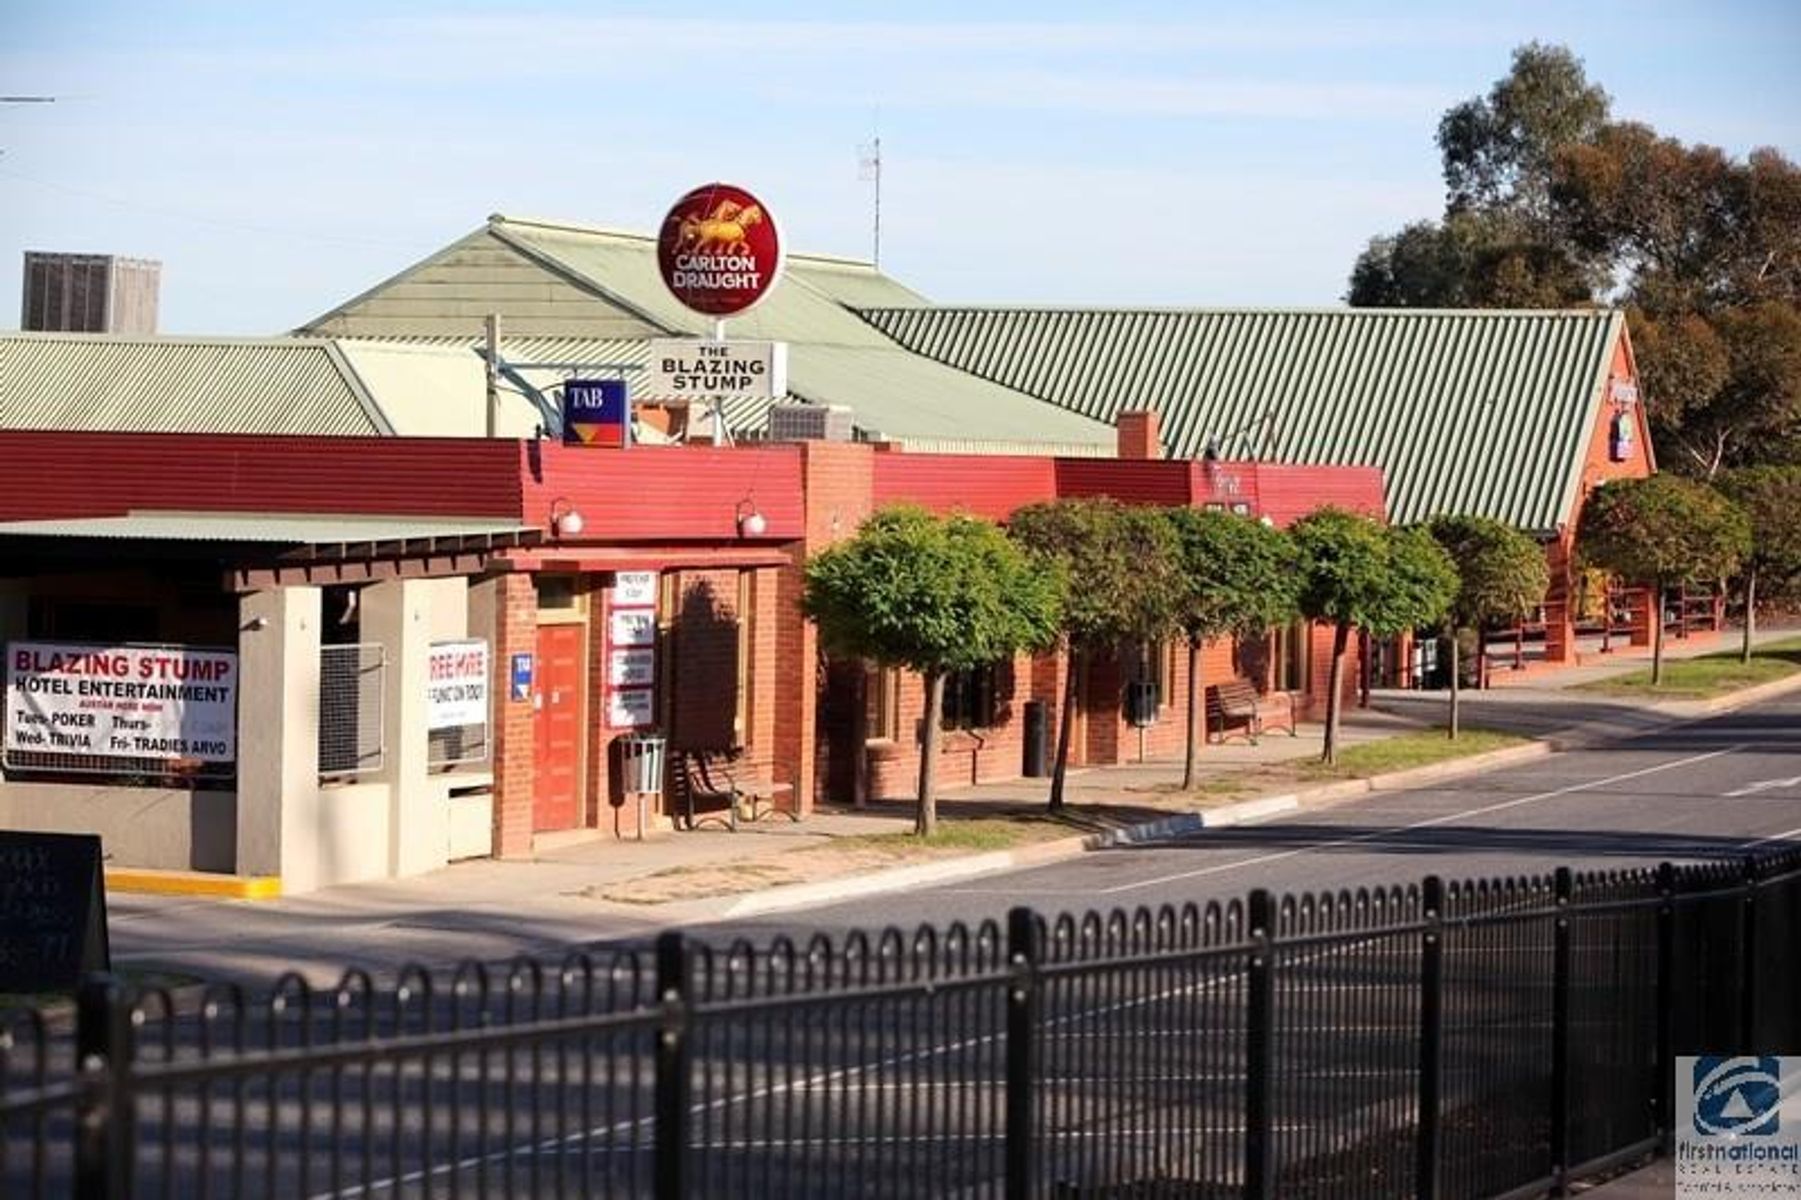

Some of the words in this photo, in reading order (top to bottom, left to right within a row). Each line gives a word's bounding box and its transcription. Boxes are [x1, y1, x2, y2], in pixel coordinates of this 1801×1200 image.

[676, 255, 756, 271] CARLTON
[673, 271, 761, 289] DRAUGHT
[700, 347, 729, 357] THE
[662, 359, 765, 375] BLAZING
[673, 376, 752, 390] STUMP
[571, 387, 603, 408] TAB
[16, 650, 129, 677] BLAZING
[139, 656, 230, 682] STUMP
[16, 676, 73, 695] HOTEL
[79, 680, 229, 703] ENTERTAINMENT
[52, 712, 95, 727] POKER
[16, 730, 46, 745] Wed-
[49, 732, 92, 748] TRIVIA
[134, 737, 188, 754] TRADIES
[191, 741, 226, 756] ARVO
